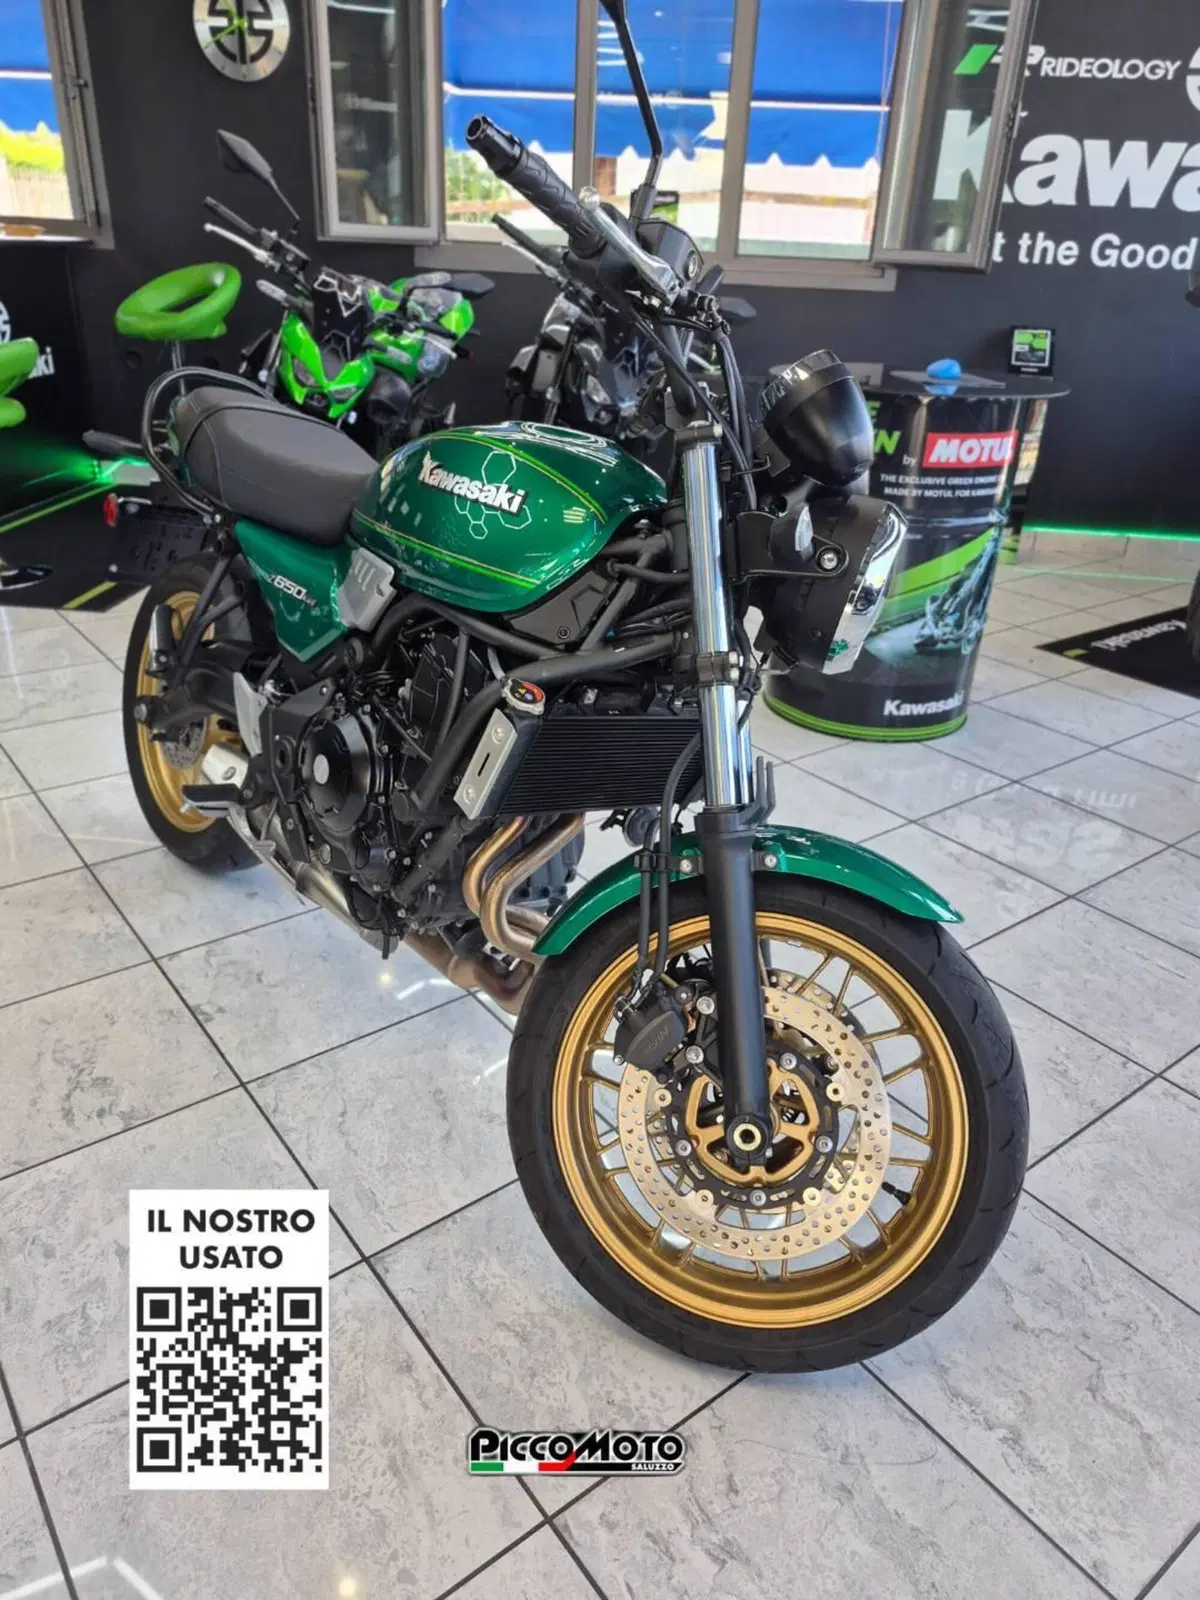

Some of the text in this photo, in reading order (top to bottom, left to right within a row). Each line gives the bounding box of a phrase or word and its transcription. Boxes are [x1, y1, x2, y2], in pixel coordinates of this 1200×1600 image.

[1040, 57, 1182, 81] RIDEOLOGY
[1018, 232, 1079, 266] the
[1091, 233, 1199, 270] Good
[902, 454, 917, 467] by
[418, 450, 526, 514] Kawasaki
[880, 473, 896, 483] THE
